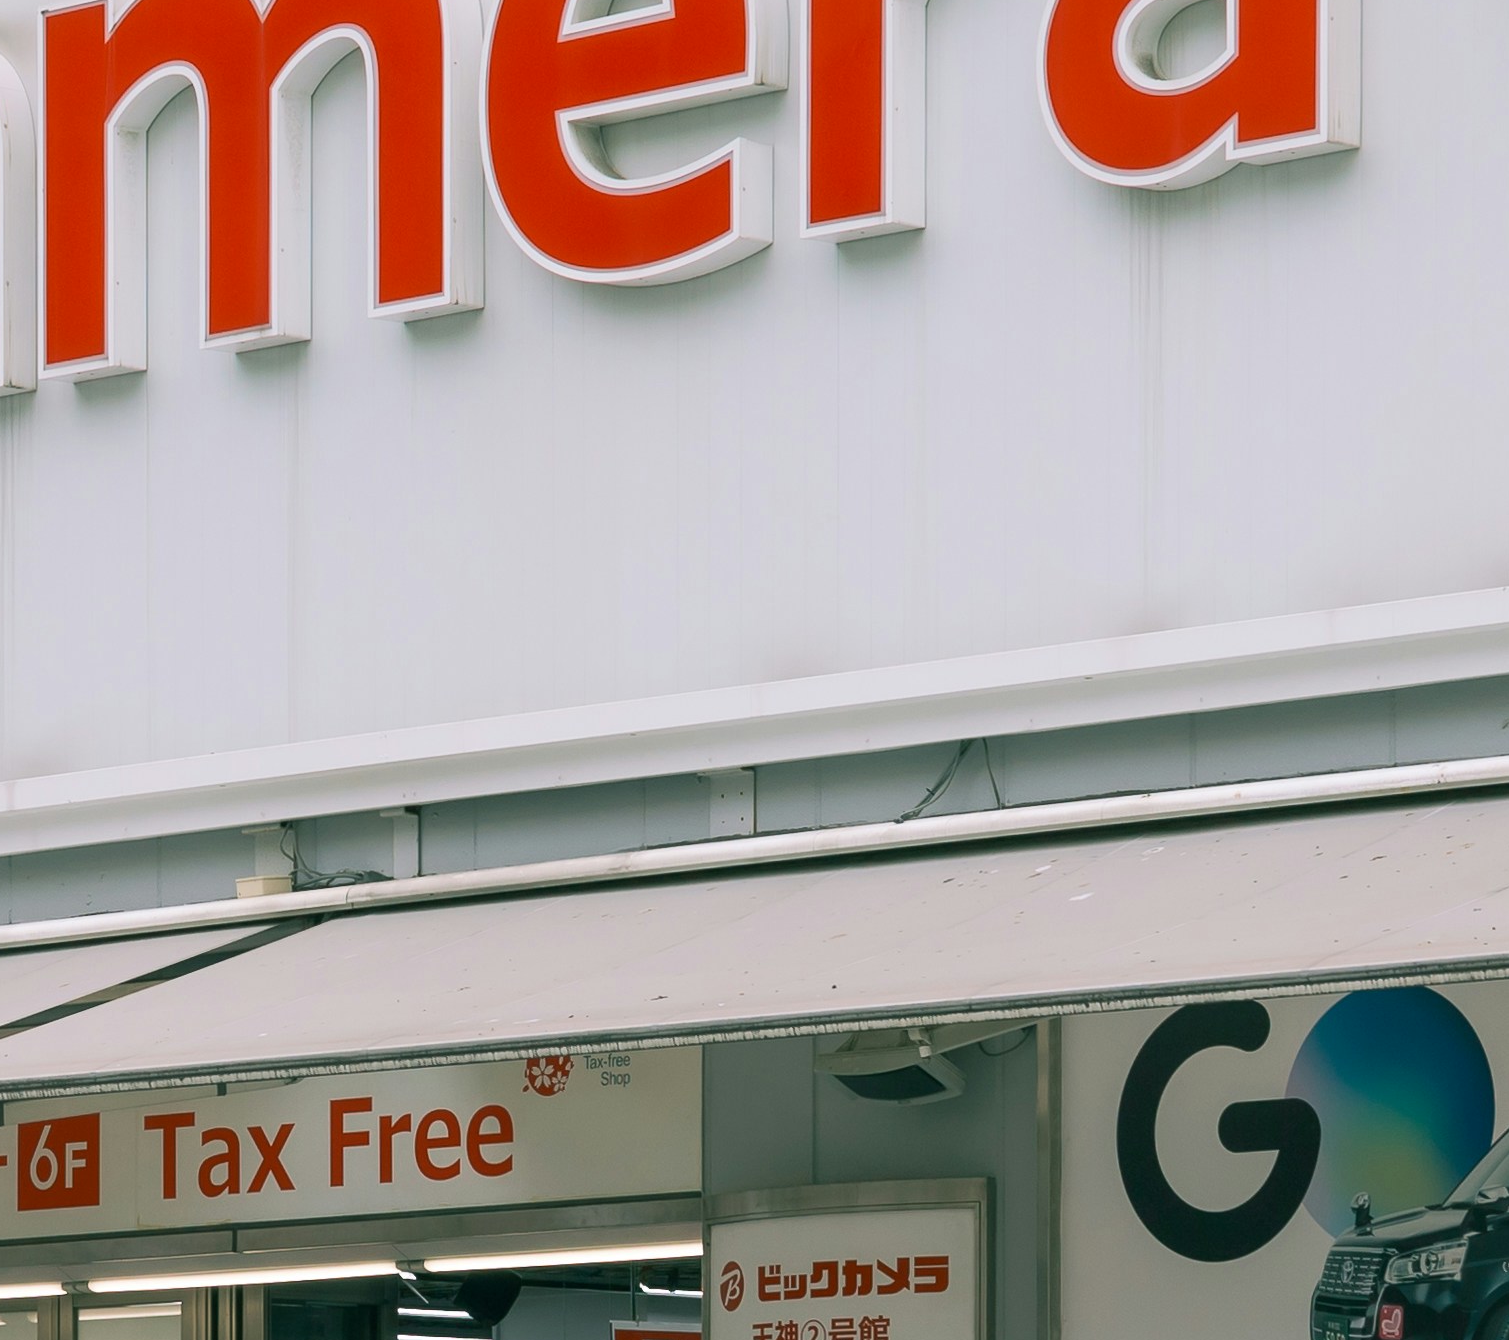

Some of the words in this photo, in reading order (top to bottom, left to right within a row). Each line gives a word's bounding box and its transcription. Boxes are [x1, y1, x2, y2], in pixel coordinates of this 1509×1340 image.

[600, 1071, 631, 1089] Shop
[145, 1112, 296, 1201] Tax
[329, 1097, 515, 1190] Free
[758, 1255, 949, 1302] ビックカメラ
